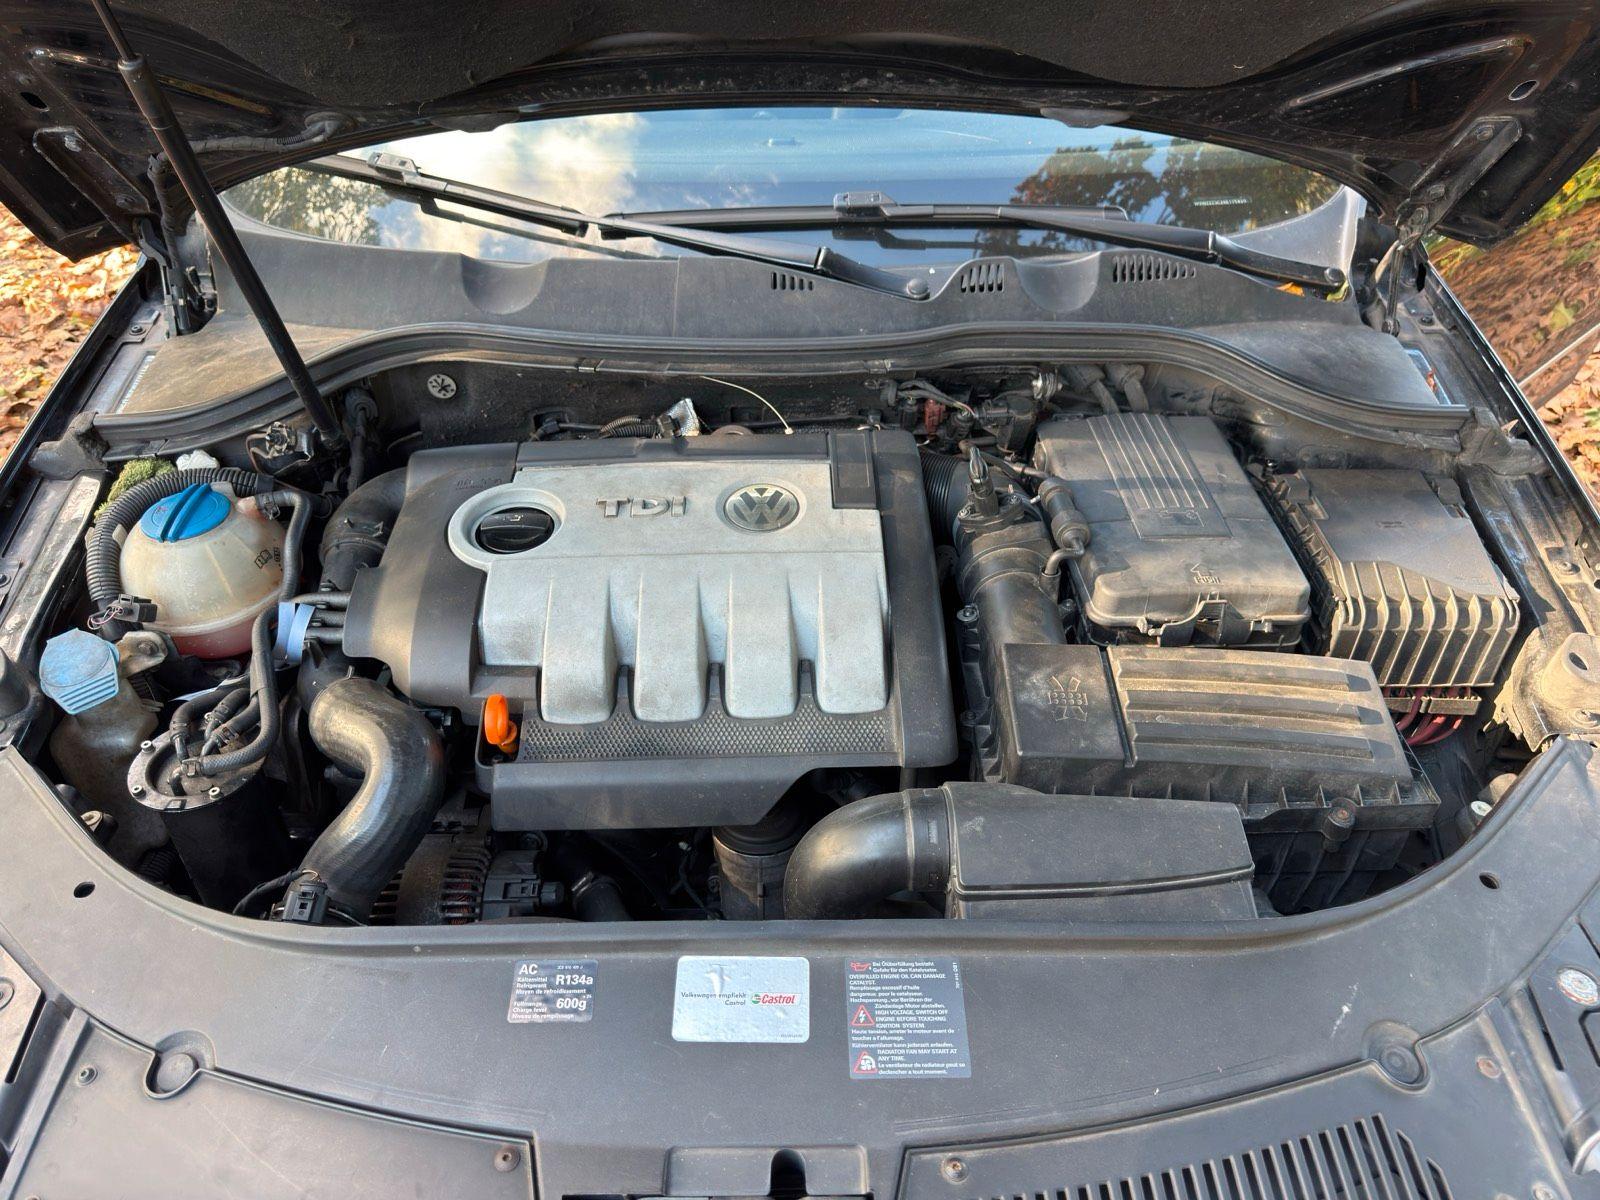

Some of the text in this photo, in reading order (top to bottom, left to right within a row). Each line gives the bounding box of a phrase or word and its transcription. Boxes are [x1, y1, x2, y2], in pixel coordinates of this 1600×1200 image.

[596, 496, 687, 518] TDI
[723, 483, 801, 532] VW
[518, 963, 538, 975] AC
[555, 974, 594, 986] R134a
[681, 992, 747, 1000] Volkswagen empfiehlt
[761, 994, 796, 1005] Castrol
[555, 998, 587, 1011] 600g
